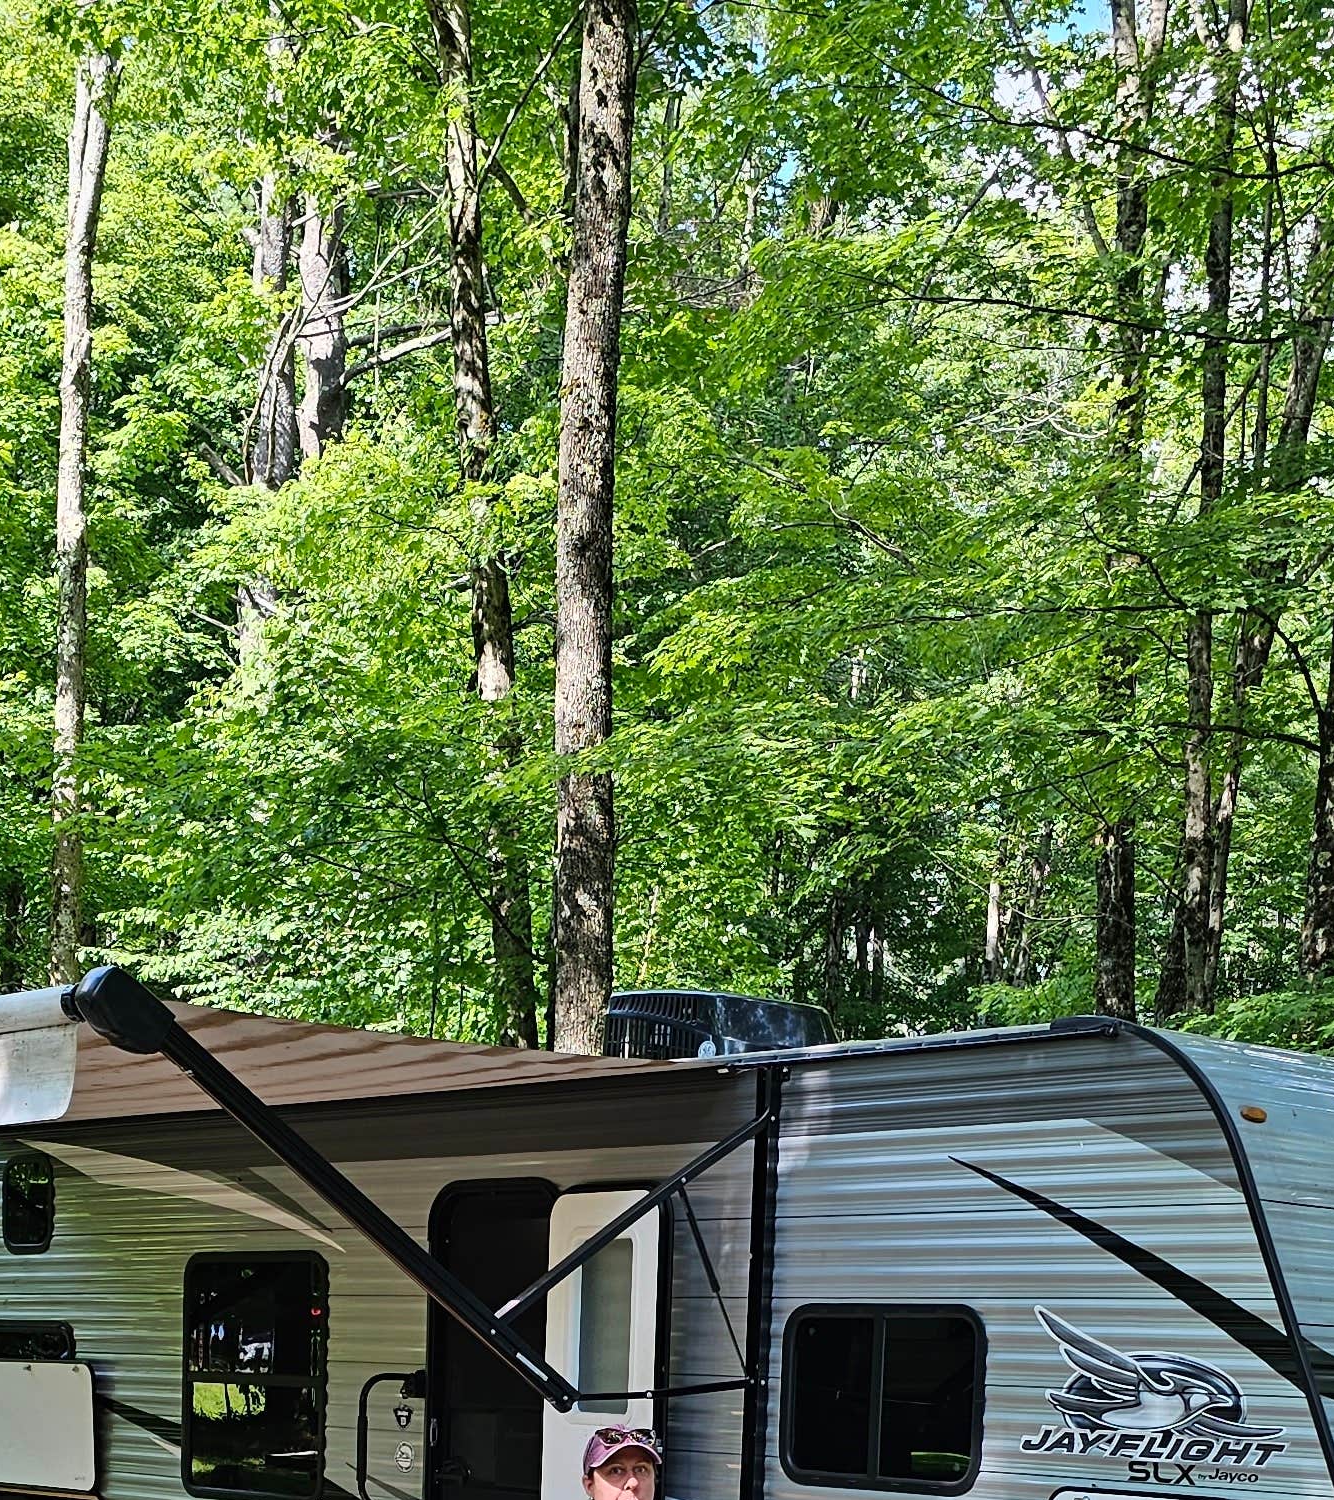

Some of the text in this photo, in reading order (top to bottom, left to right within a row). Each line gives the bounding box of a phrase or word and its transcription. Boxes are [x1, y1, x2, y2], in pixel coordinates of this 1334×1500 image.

[1110, 1433, 1287, 1467] FLIGHT
[1128, 1460, 1196, 1486] SLX
[1208, 1468, 1259, 1484] Jayco
